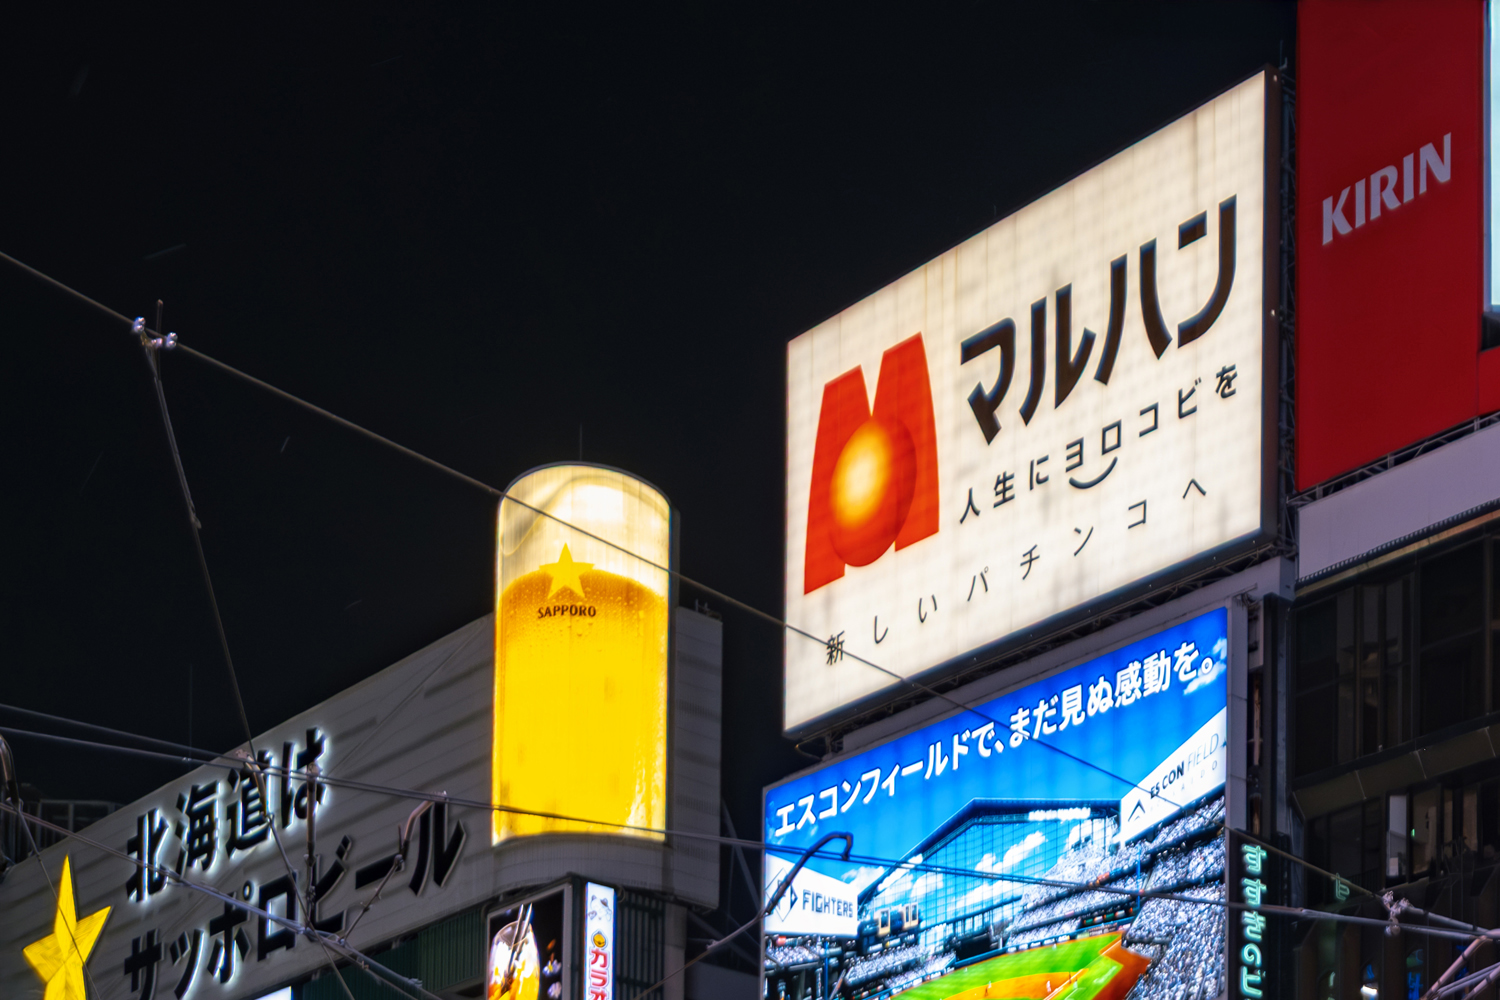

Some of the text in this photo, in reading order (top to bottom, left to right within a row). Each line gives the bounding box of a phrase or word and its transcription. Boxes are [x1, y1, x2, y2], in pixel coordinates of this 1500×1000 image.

[1321, 133, 1453, 245] KIRIN
[960, 193, 1237, 445] マルハン
[958, 363, 1237, 525] 人生にヨロコビを
[537, 604, 597, 619] SAPPORO
[825, 478, 1207, 667] 新しいパチンコへ
[126, 727, 329, 904] 北海道は
[775, 641, 1215, 837] エスコンフィールドで、まだ見ぬ感動を。
[802, 888, 853, 918] FIGHTERS
